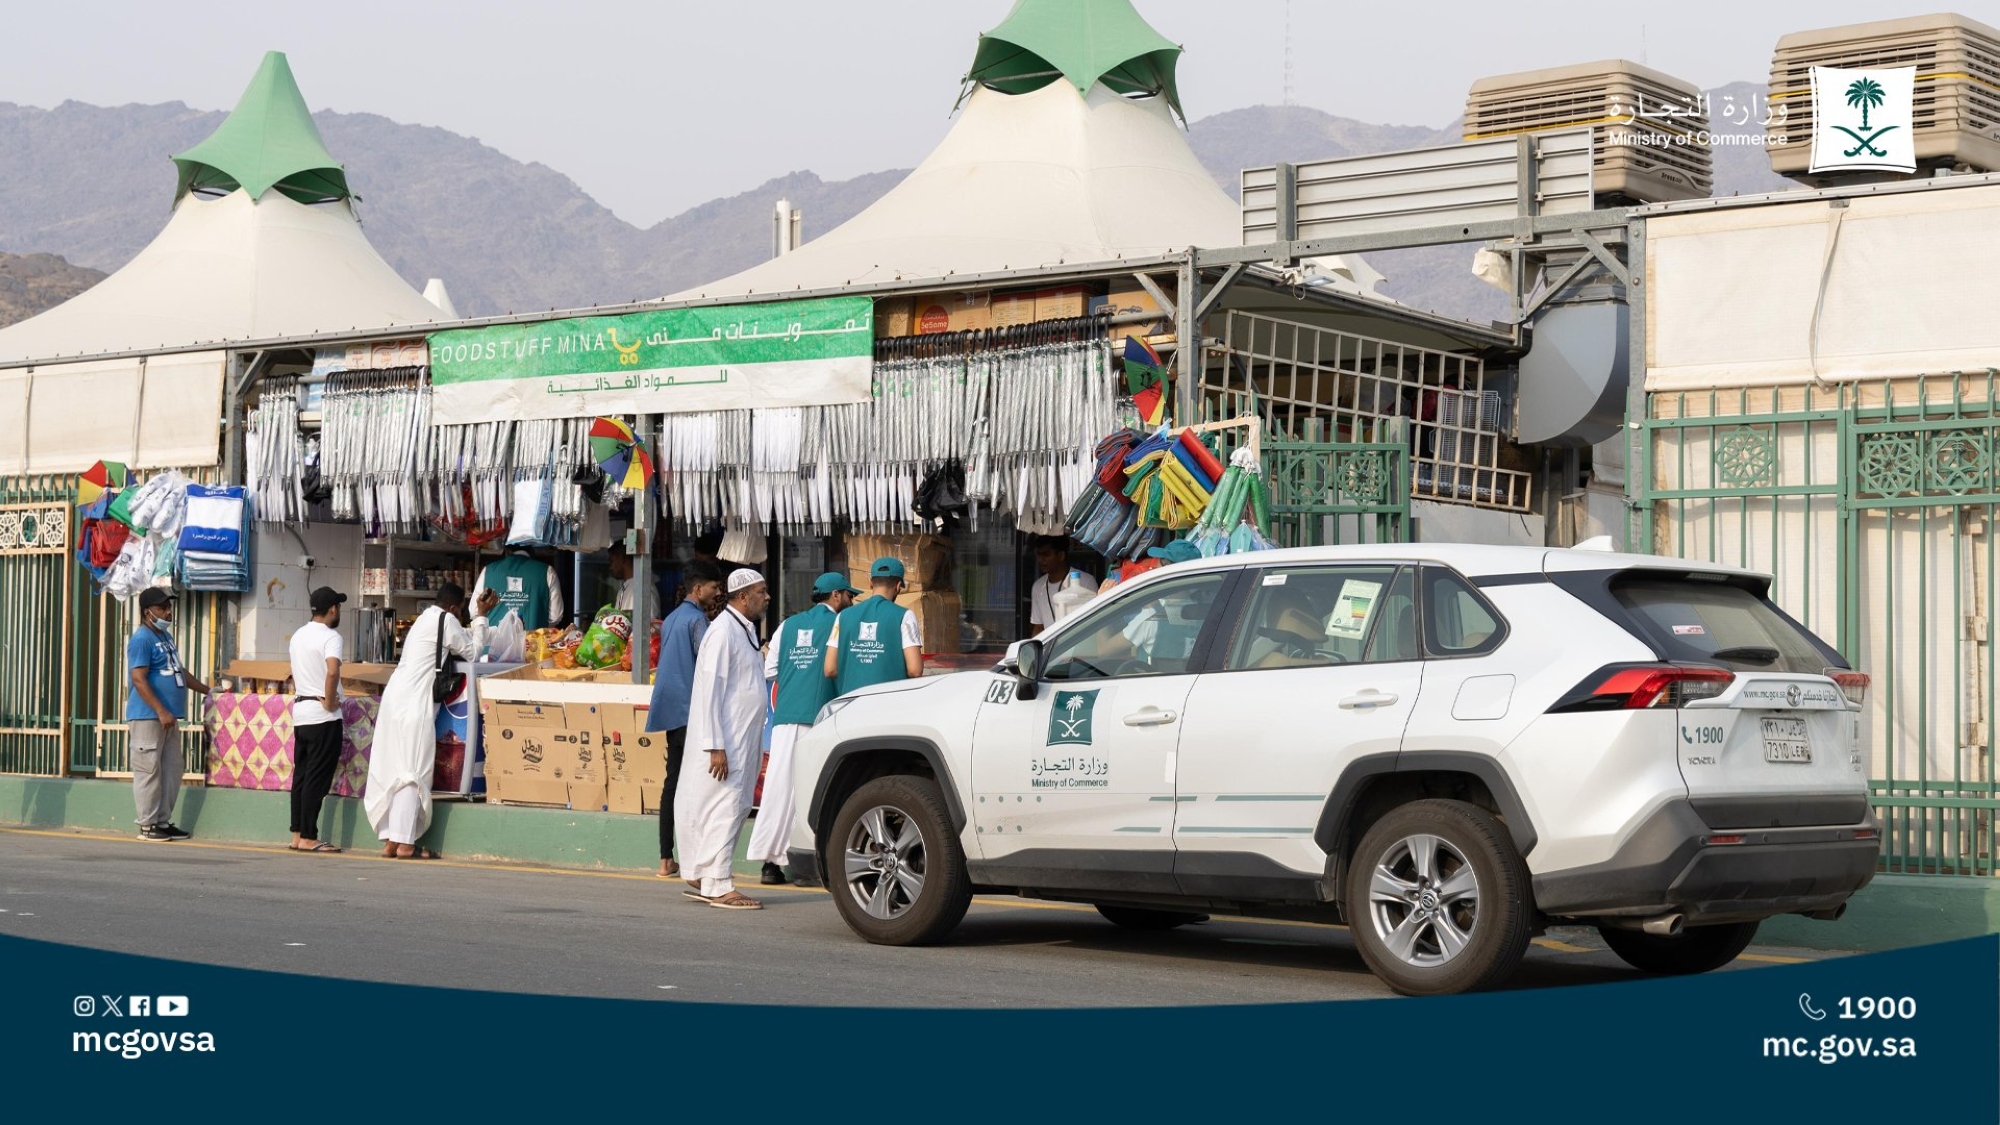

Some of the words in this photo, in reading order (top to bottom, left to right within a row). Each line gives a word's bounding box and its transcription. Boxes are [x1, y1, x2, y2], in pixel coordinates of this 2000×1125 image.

[725, 312, 870, 342] تموينات
[431, 337, 552, 365] FOODSTUFF
[558, 333, 605, 354] MINA
[547, 374, 641, 397] الغذائية
[644, 369, 728, 391] للمواد
[987, 680, 1014, 704] 03
[1695, 726, 1723, 744] 1900
[1031, 756, 1075, 776] التجارة
[1079, 756, 1108, 775] وزارة
[1032, 778, 1058, 789] Ministry
[1060, 778, 1067, 787] of
[1068, 778, 1108, 788] Commerce
